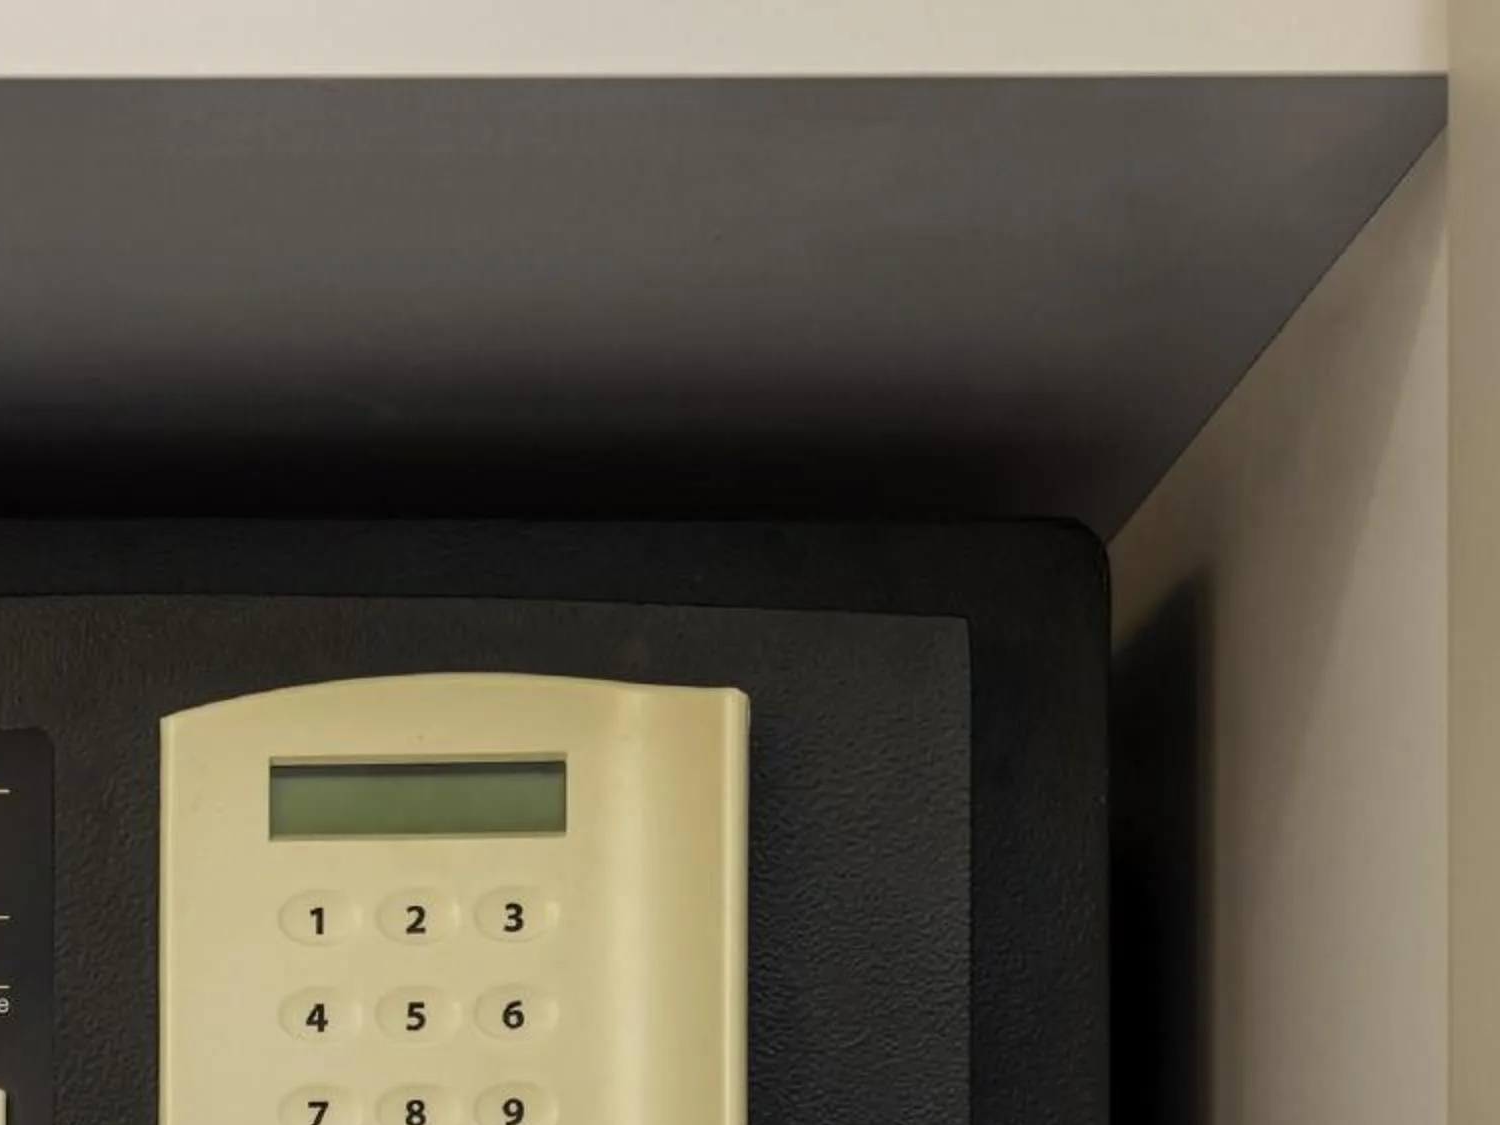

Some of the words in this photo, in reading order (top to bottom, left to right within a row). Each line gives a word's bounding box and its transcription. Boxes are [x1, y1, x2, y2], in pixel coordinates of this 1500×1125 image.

[309, 907, 326, 935] 1
[405, 905, 427, 934] 2
[503, 903, 525, 933] 3
[305, 1003, 329, 1033] 4
[406, 1002, 426, 1032] 5
[502, 1001, 525, 1030] 6
